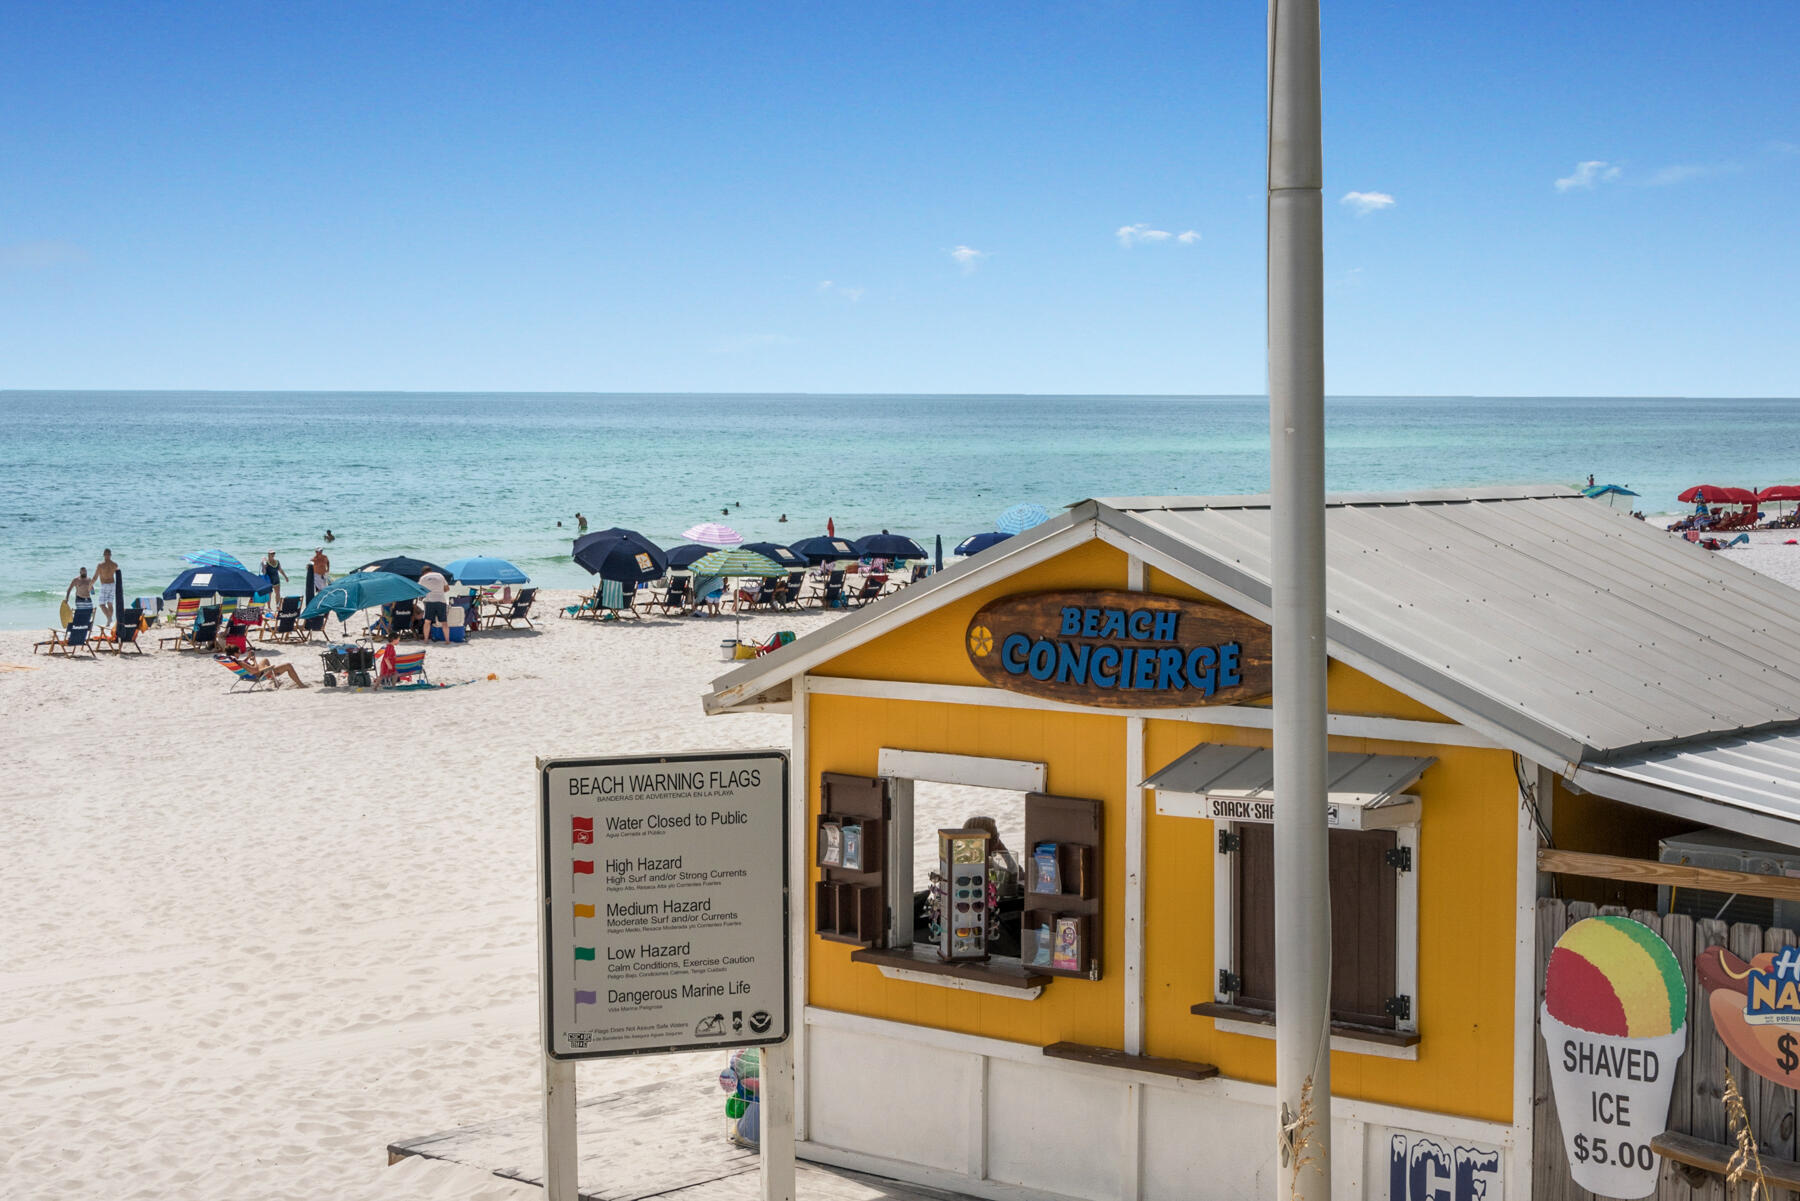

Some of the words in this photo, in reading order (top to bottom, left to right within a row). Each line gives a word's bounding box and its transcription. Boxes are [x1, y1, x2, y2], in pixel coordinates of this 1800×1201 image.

[1058, 606, 1179, 641] BEACH
[1001, 632, 1241, 697] CONCIERGE
[569, 776, 624, 796] BEACH
[629, 772, 705, 792] WARNING
[710, 769, 761, 788] FLAGS
[645, 792, 692, 800] ADVERTENCIA
[606, 817, 643, 831] Water
[647, 813, 691, 829] Closed
[695, 813, 707, 825] to
[711, 811, 748, 825] Public
[606, 858, 633, 875] High
[637, 856, 682, 871] Hazard
[606, 876, 626, 885] High
[629, 874, 647, 883] Surf
[649, 872, 676, 882] and/or
[679, 871, 708, 880] Strong
[710, 869, 747, 878] Currents
[606, 902, 658, 917] Medium
[663, 898, 711, 913] Hazard
[607, 917, 648, 927] Moderate
[651, 915, 669, 924] Surf
[671, 913, 698, 923] and/or
[701, 912, 738, 921] Currents
[607, 947, 636, 960] Low
[640, 942, 690, 958] Hazard
[608, 963, 631, 973] Calm
[633, 960, 680, 971] Conditions,
[683, 958, 720, 967] Exercise
[722, 955, 755, 964] Caution
[608, 988, 678, 1005] Dangerous
[682, 983, 724, 998] Marine
[728, 980, 751, 995] Life
[1563, 1040, 1659, 1082] SHAVED
[1592, 1091, 1631, 1127] ICE
[1573, 1133, 1654, 1171] $5.00
